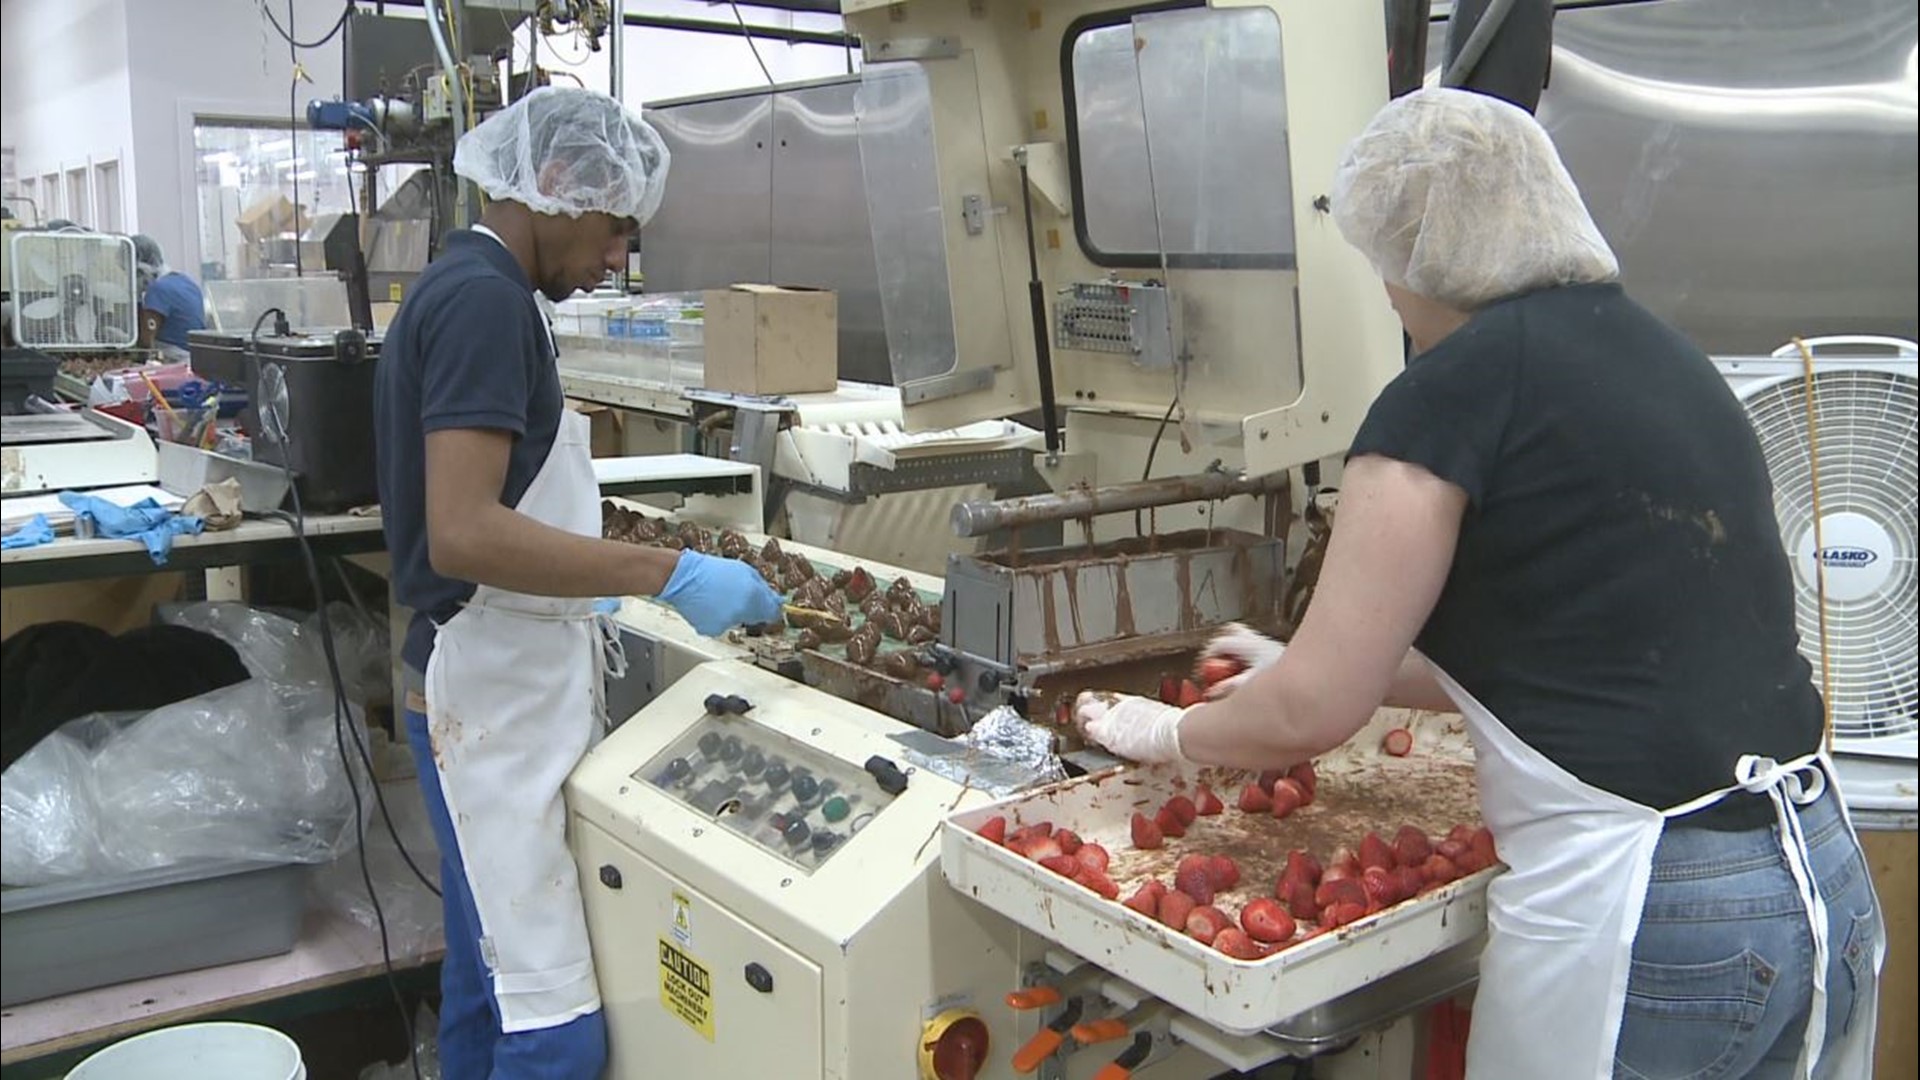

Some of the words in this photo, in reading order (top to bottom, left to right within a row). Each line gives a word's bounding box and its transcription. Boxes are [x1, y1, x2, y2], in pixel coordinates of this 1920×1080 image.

[1822, 550, 1869, 561] LASKO
[660, 943, 709, 993] CAUTION
[664, 980, 708, 1019] MACHINERY
[666, 971, 687, 993] LOCK
[688, 987, 703, 1005] OUT
